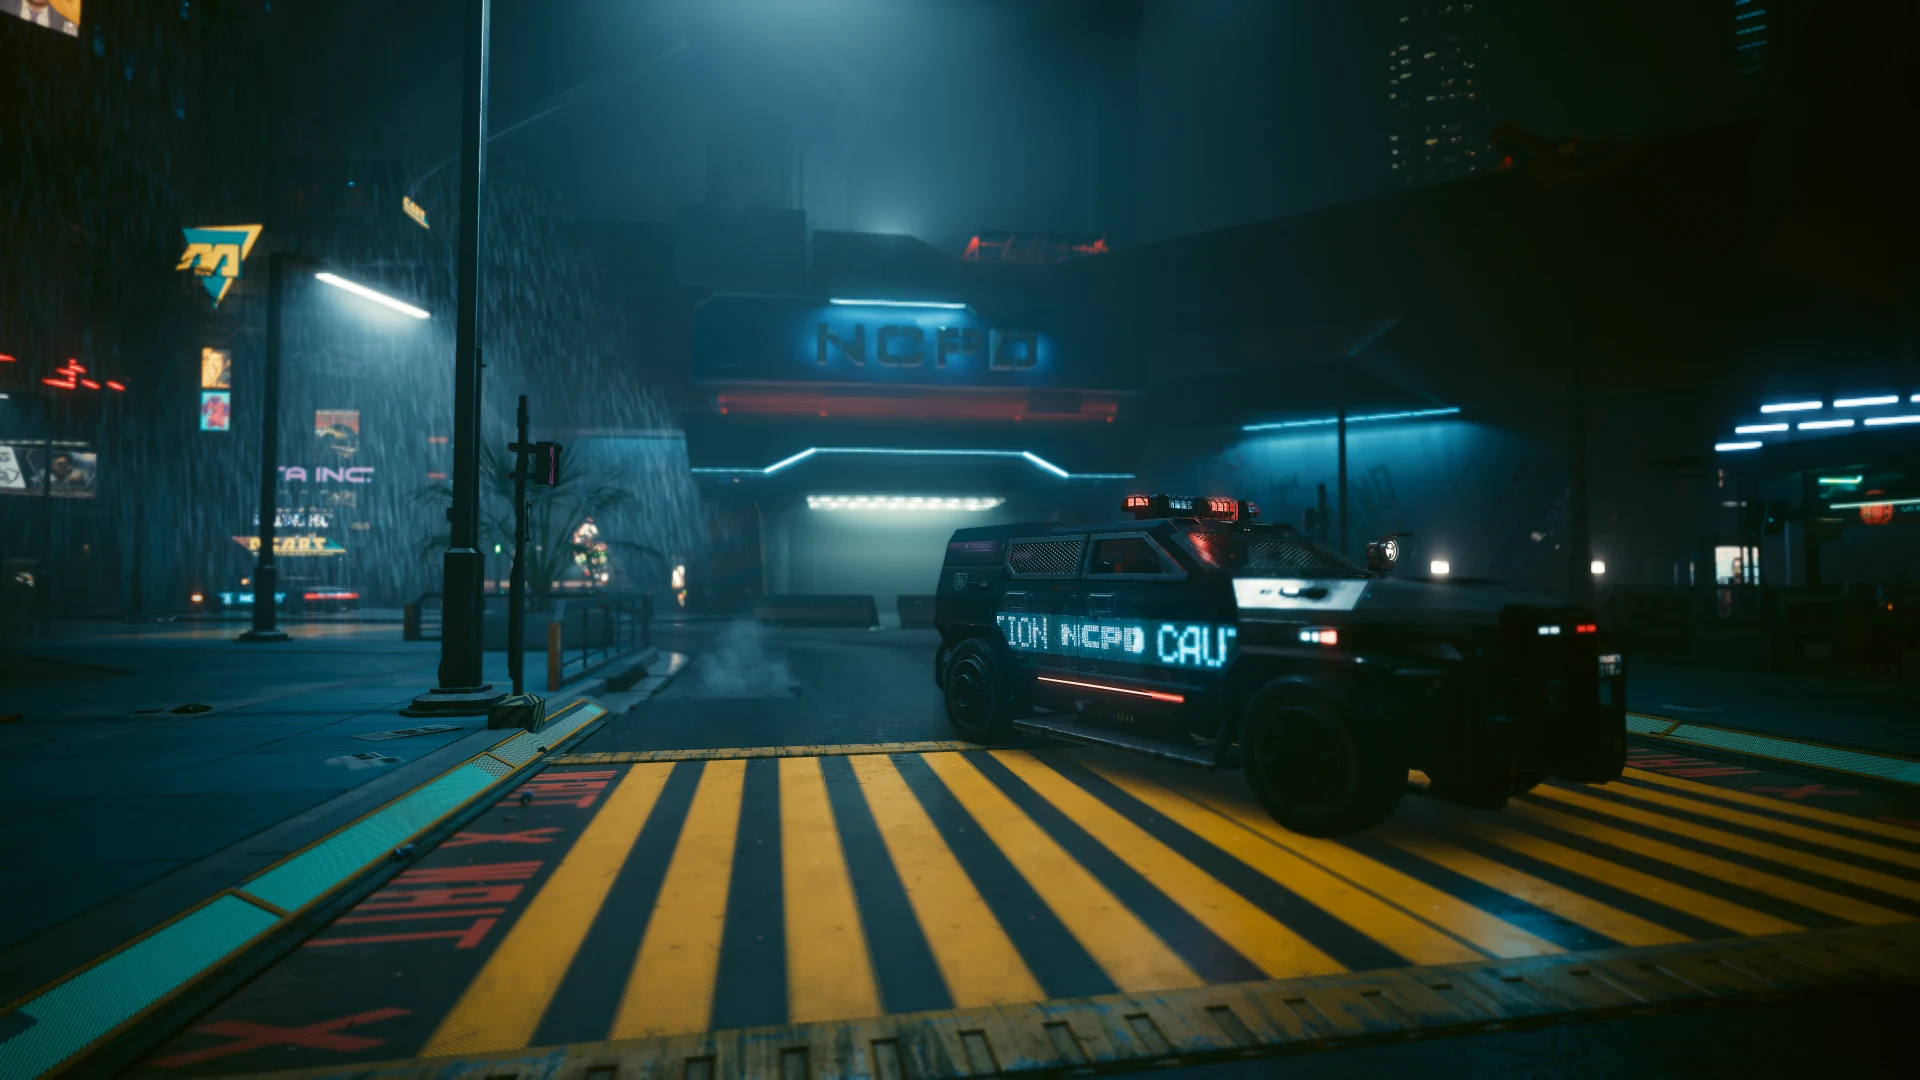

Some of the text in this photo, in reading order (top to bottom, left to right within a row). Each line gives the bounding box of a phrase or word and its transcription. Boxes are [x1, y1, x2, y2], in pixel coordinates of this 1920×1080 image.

[816, 322, 1039, 372] NCPD
[315, 466, 375, 483] INC.
[1061, 623, 1146, 653] NCPD
[303, 860, 545, 950] WAIT
